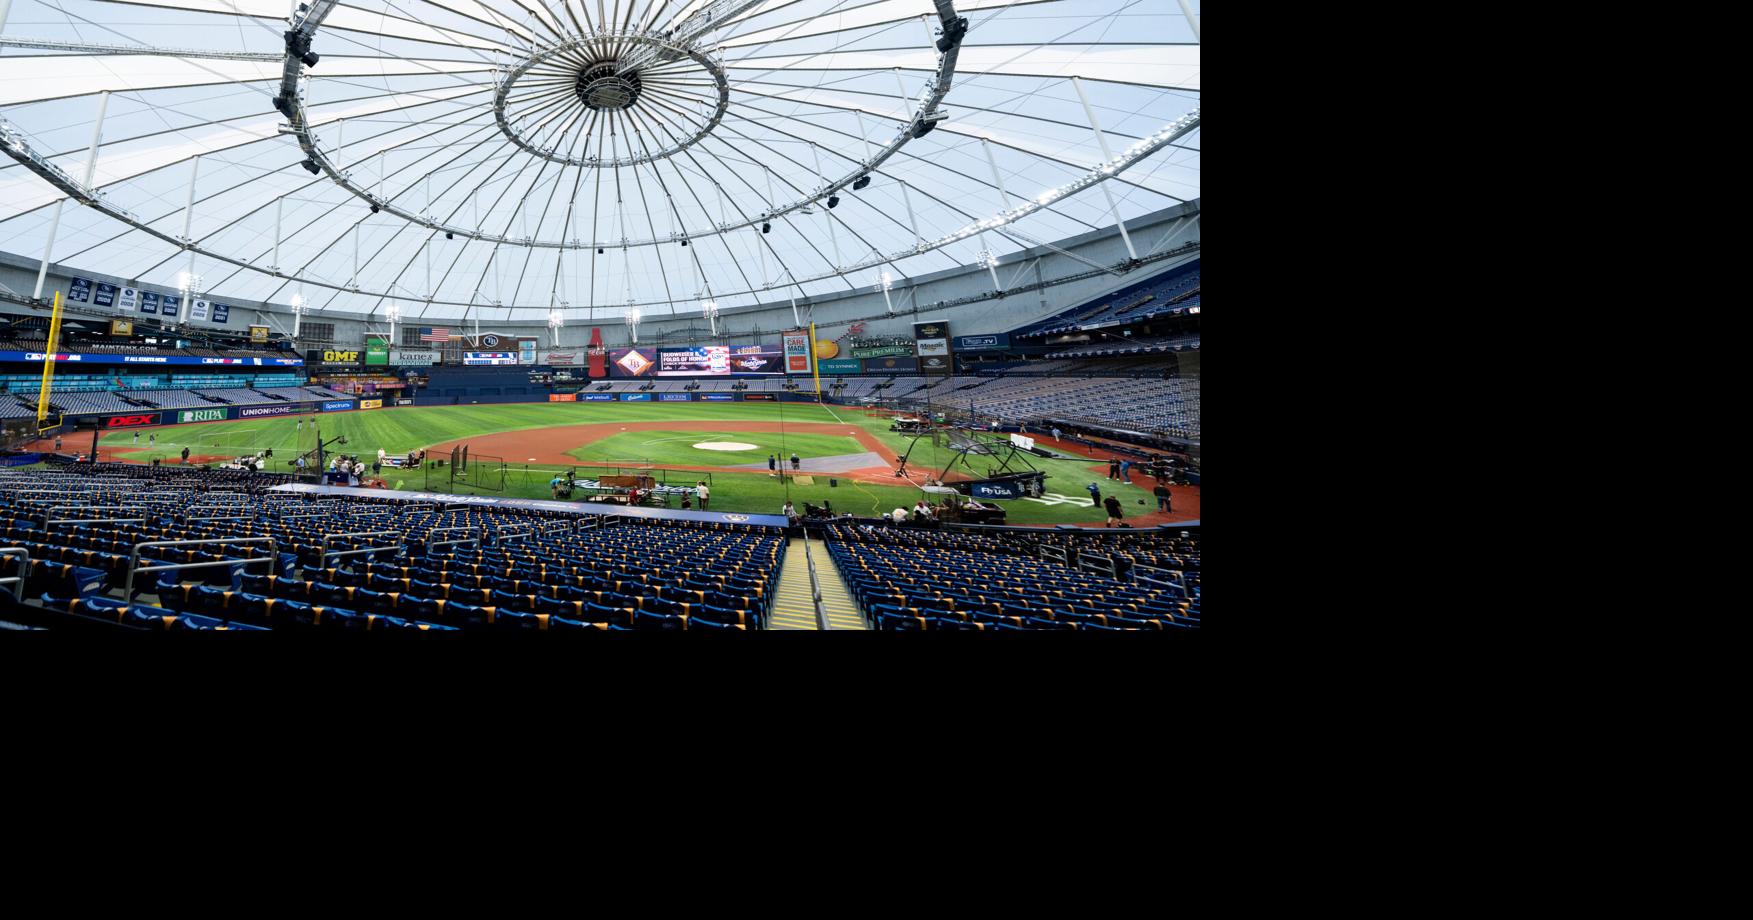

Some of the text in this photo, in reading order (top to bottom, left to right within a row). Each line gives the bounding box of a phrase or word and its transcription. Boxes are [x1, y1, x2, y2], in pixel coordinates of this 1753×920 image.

[323, 351, 359, 362] GMF
[108, 414, 154, 427] DEX
[194, 409, 223, 422] RIPA
